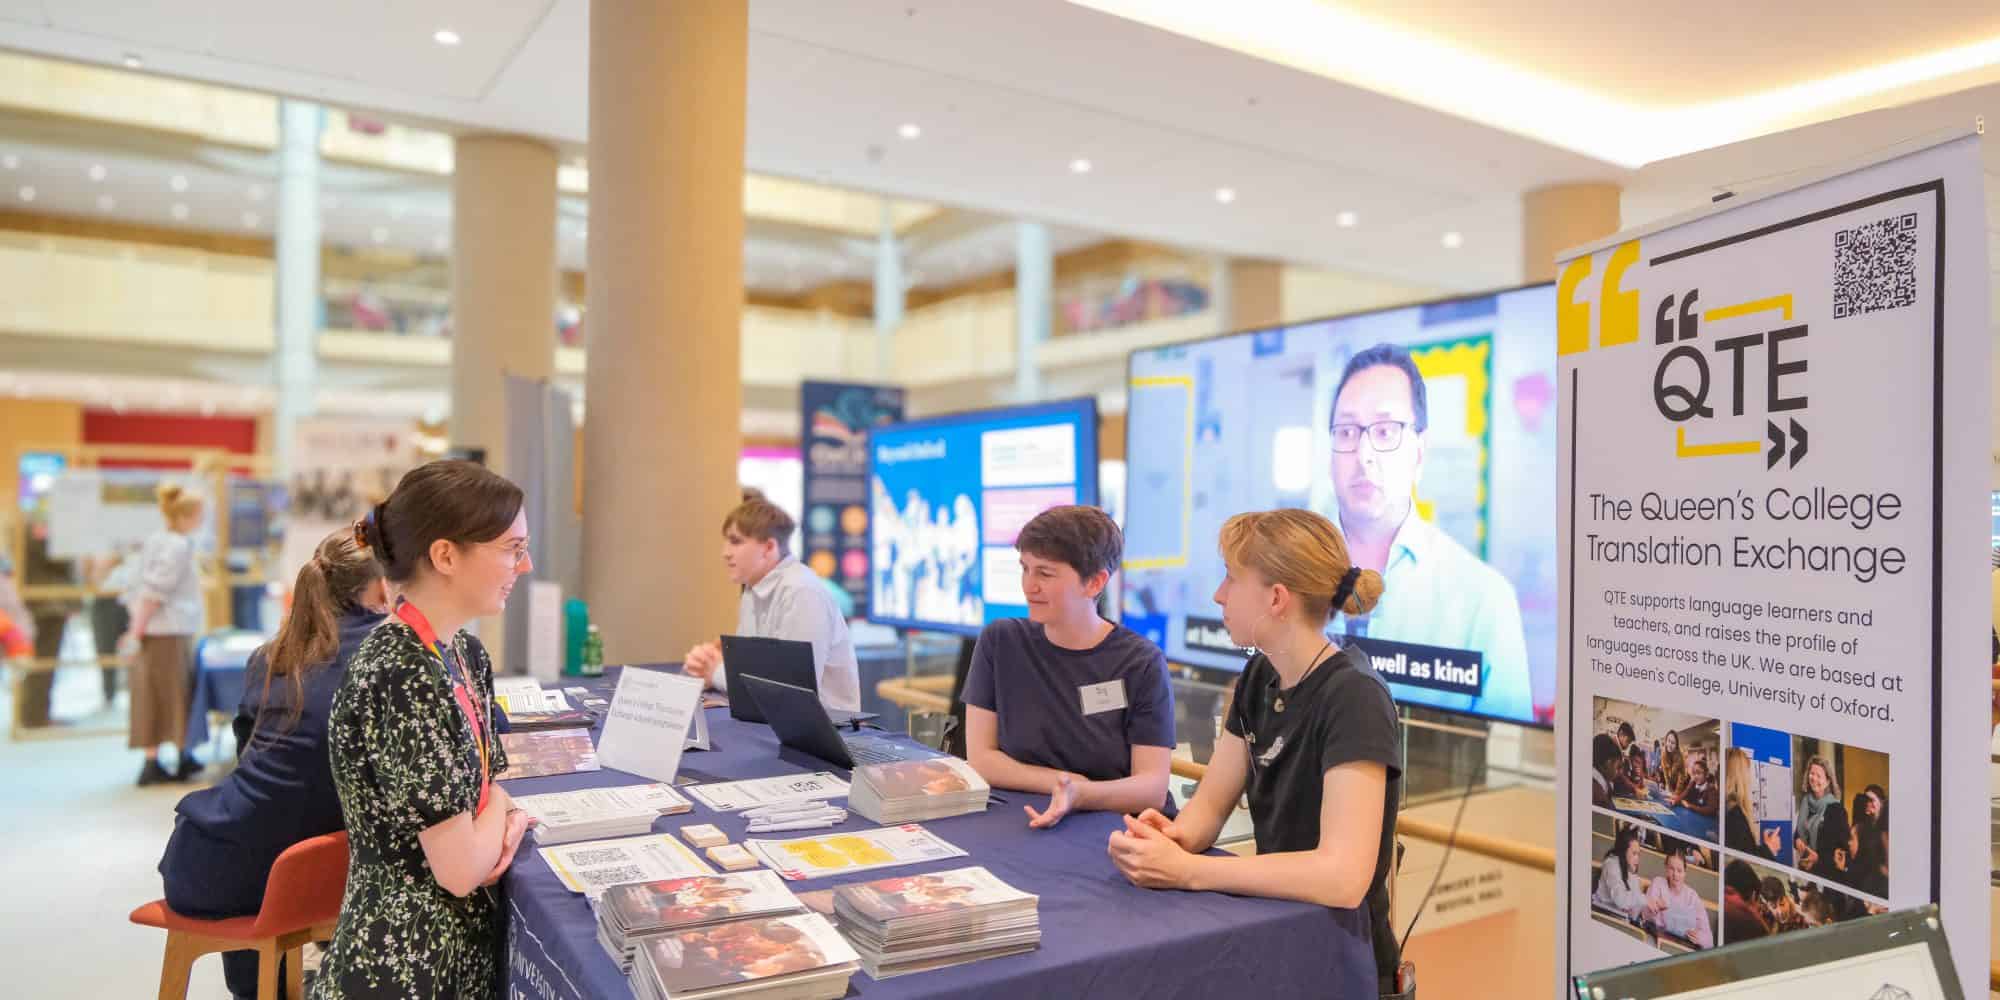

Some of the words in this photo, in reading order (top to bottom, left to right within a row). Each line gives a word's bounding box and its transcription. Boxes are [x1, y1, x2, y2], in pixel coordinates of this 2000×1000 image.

[1653, 324, 1809, 422] QTE
[1589, 493, 1632, 521] The
[1640, 489, 1755, 521] Queen's
[1766, 486, 1902, 530] College
[1586, 534, 1722, 567] Translation
[1734, 535, 1906, 584] Exchange
[1604, 590, 1627, 606] QTE
[1630, 593, 1686, 612] supports
[1689, 596, 1763, 621] language
[1768, 602, 1833, 624] learners
[1838, 609, 1873, 626] and
[1614, 615, 1671, 637] teachers,
[1674, 623, 1701, 637] and
[1705, 624, 1751, 643] raises
[1756, 628, 1781, 646] the
[1786, 633, 1836, 653] profile
[1841, 638, 1859, 656] of
[1371, 653, 1406, 675] well
[1410, 661, 1431, 679] as
[1434, 658, 1478, 686] kind
[1586, 634, 1652, 658] languages
[1655, 645, 1699, 663] across
[1702, 649, 1727, 667] the
[1731, 652, 1755, 671] UK.
[1759, 656, 1785, 675] We
[1789, 663, 1816, 680] are
[1821, 663, 1876, 689] based
[1882, 675, 1904, 693] at
[1591, 658, 1613, 674] The
[1615, 662, 1665, 684] Queen's
[1667, 671, 1724, 696] College,
[1728, 679, 1806, 711] University
[1810, 693, 1826, 711] of
[1830, 696, 1895, 723] Oxford.
